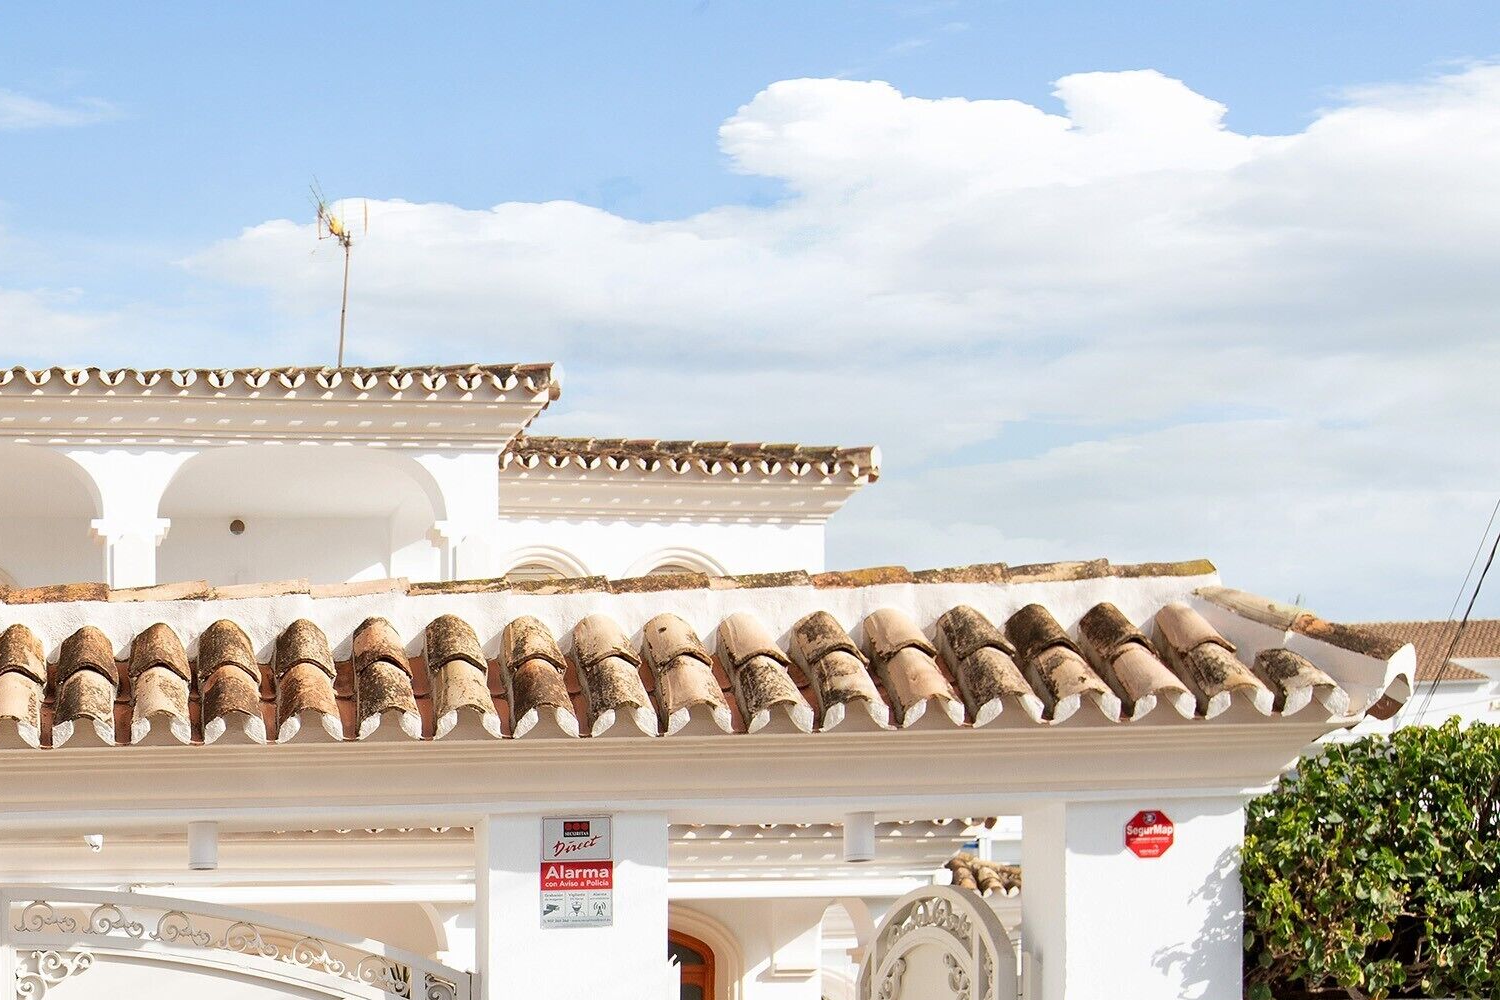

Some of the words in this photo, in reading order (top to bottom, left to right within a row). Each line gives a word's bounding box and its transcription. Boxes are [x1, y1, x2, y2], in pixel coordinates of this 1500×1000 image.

[1126, 824, 1173, 837] SegurMap
[553, 835, 602, 857] Direct
[545, 865, 609, 879] Alarma
